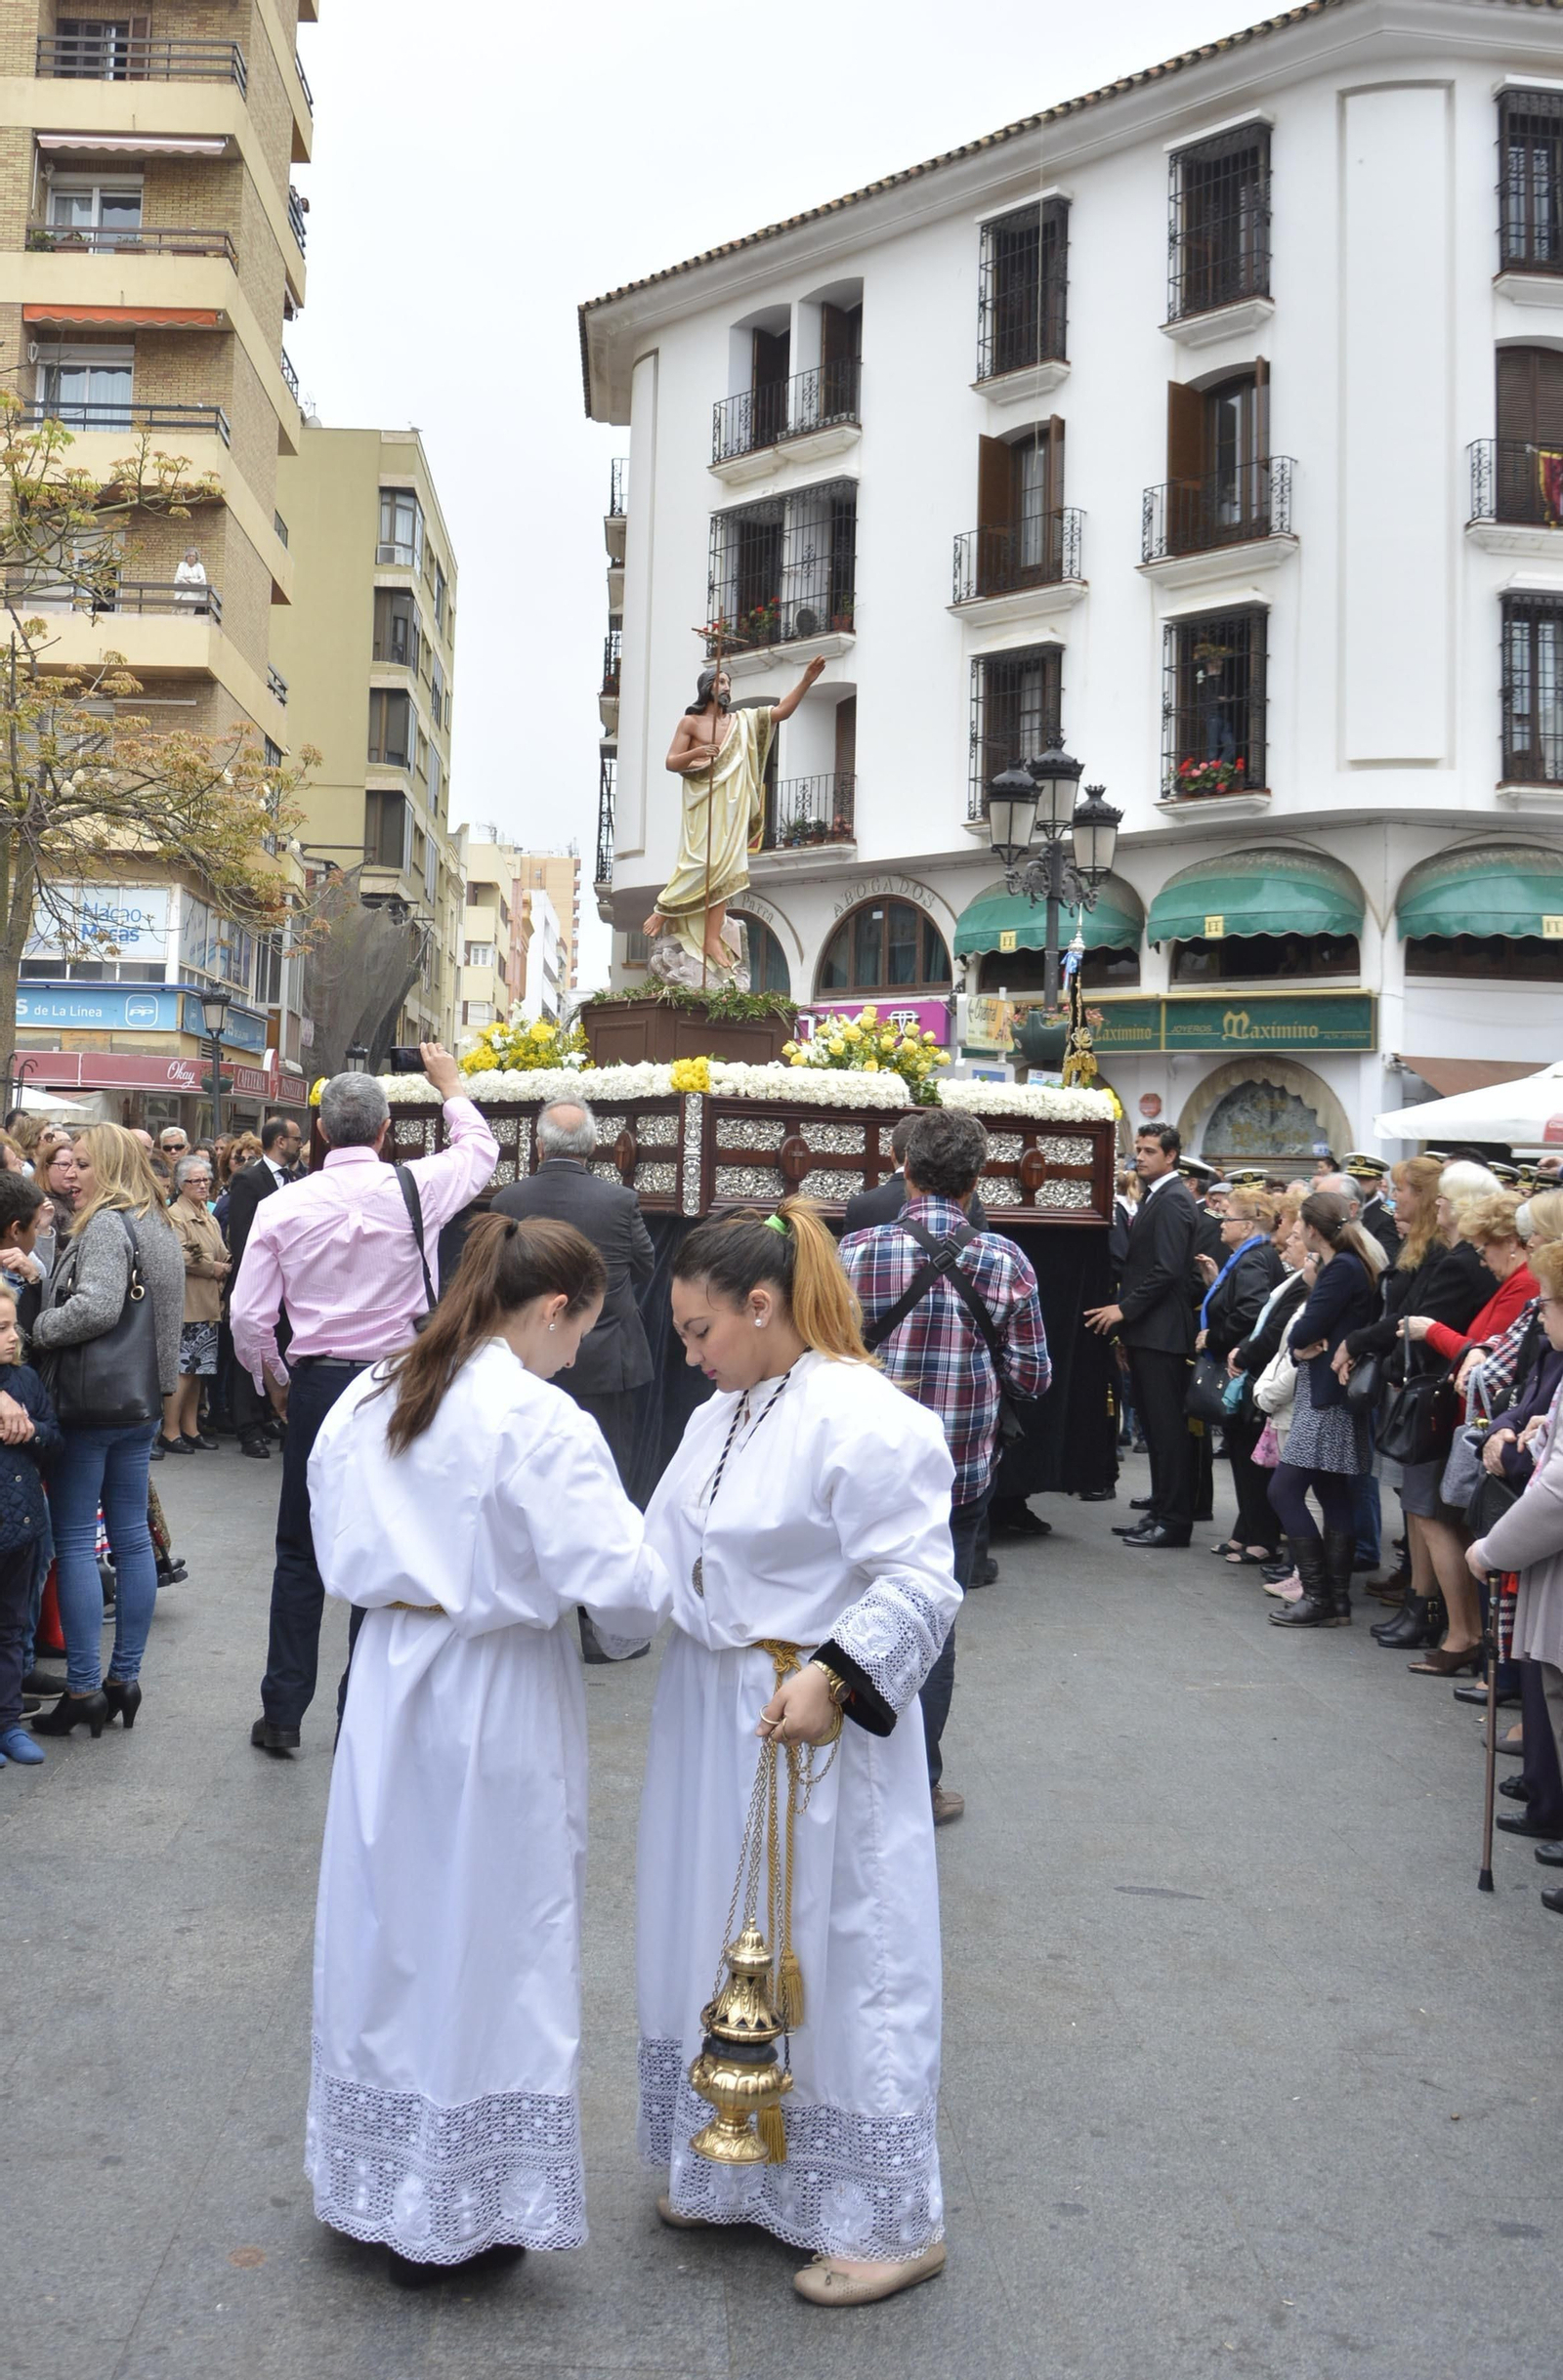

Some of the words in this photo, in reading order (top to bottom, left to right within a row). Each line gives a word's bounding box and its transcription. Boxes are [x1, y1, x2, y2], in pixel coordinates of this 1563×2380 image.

[741, 894, 775, 923] Parra
[833, 876, 936, 918] ABOGADOS
[81, 923, 140, 942] Mcas
[34, 1005, 48, 1016] de
[52, 1006, 65, 1017] La
[1171, 1024, 1211, 1033] JOYEROS
[1222, 1010, 1319, 1041] Maximino
[167, 1061, 195, 1088] Okay
[237, 1068, 265, 1092] CAFETERIA
